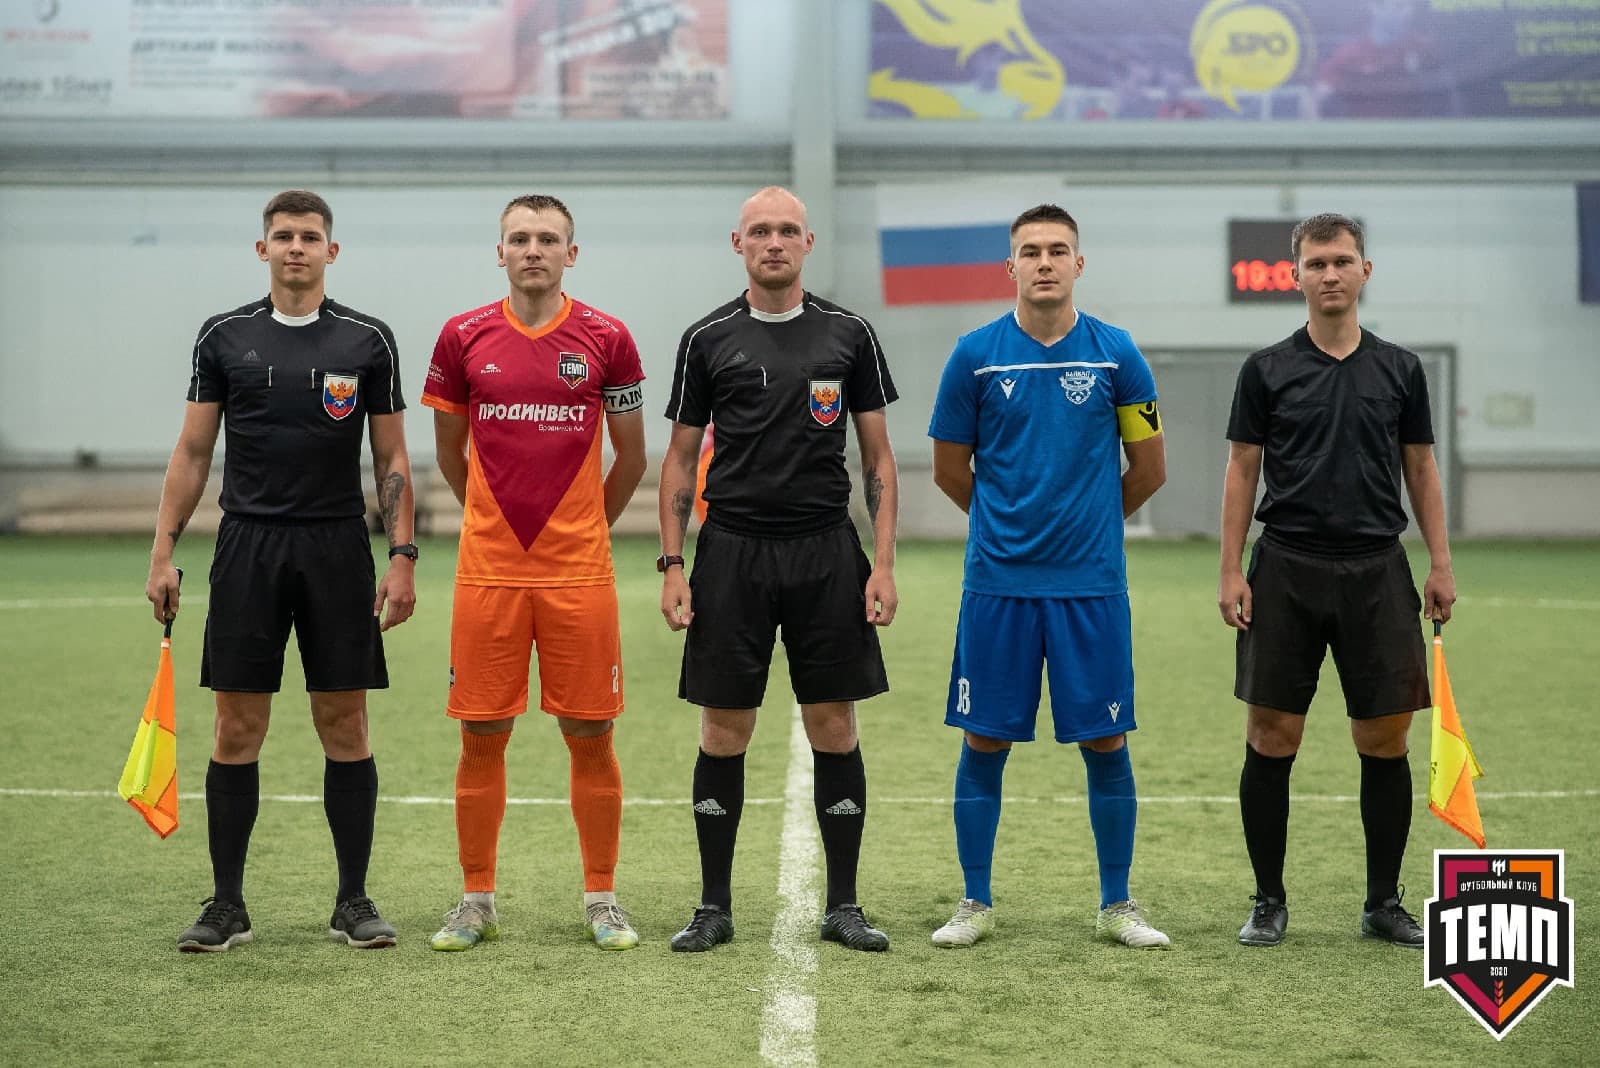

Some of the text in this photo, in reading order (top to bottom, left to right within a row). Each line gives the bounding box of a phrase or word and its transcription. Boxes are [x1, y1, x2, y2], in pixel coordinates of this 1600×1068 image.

[560, 362, 586, 376] ТЕМП
[479, 403, 587, 422] ПРОДИНВЕСТ
[694, 805, 726, 815] adidas
[825, 807, 862, 815] adidas
